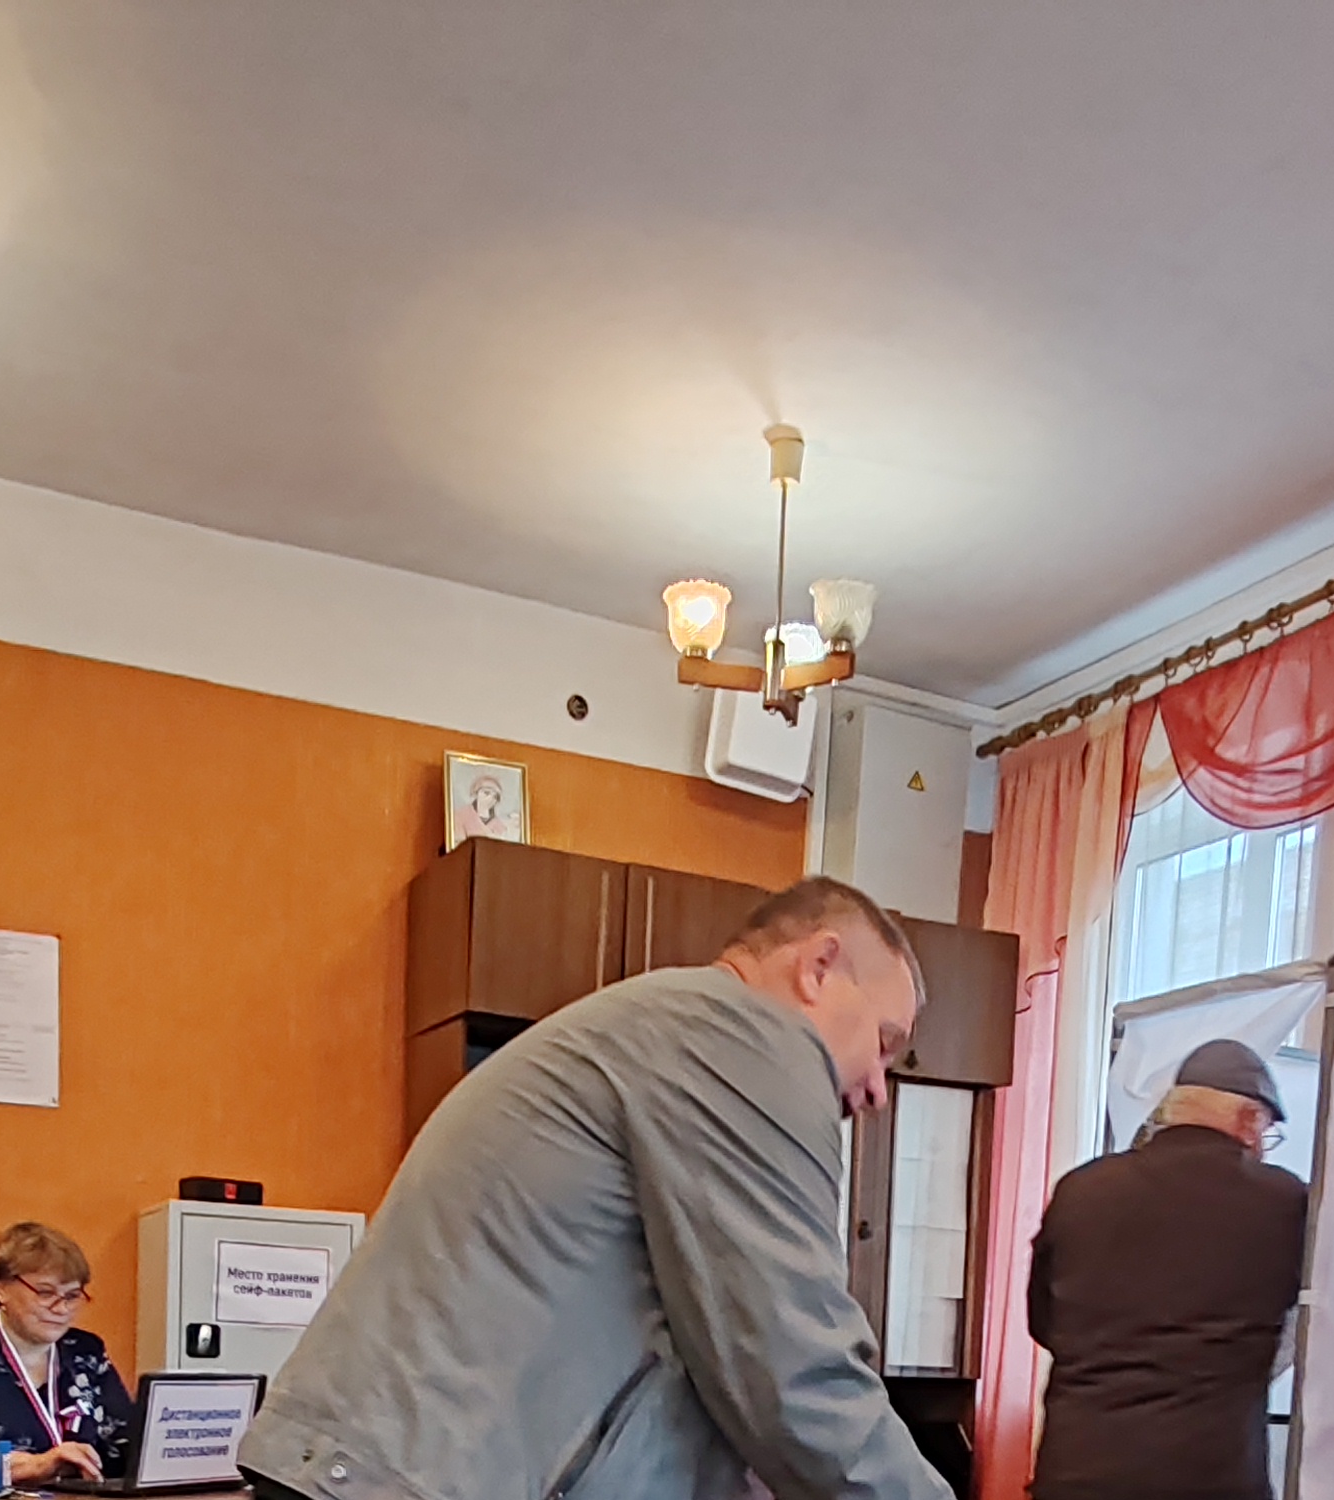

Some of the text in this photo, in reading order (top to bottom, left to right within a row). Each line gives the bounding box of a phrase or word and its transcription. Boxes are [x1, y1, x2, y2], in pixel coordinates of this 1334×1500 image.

[227, 1267, 320, 1285] Место хранения
[233, 1283, 312, 1299] сейф-пакетов
[159, 1407, 241, 1422] Дистанционное
[165, 1427, 233, 1440] электронное
[162, 1445, 229, 1459] голосование
